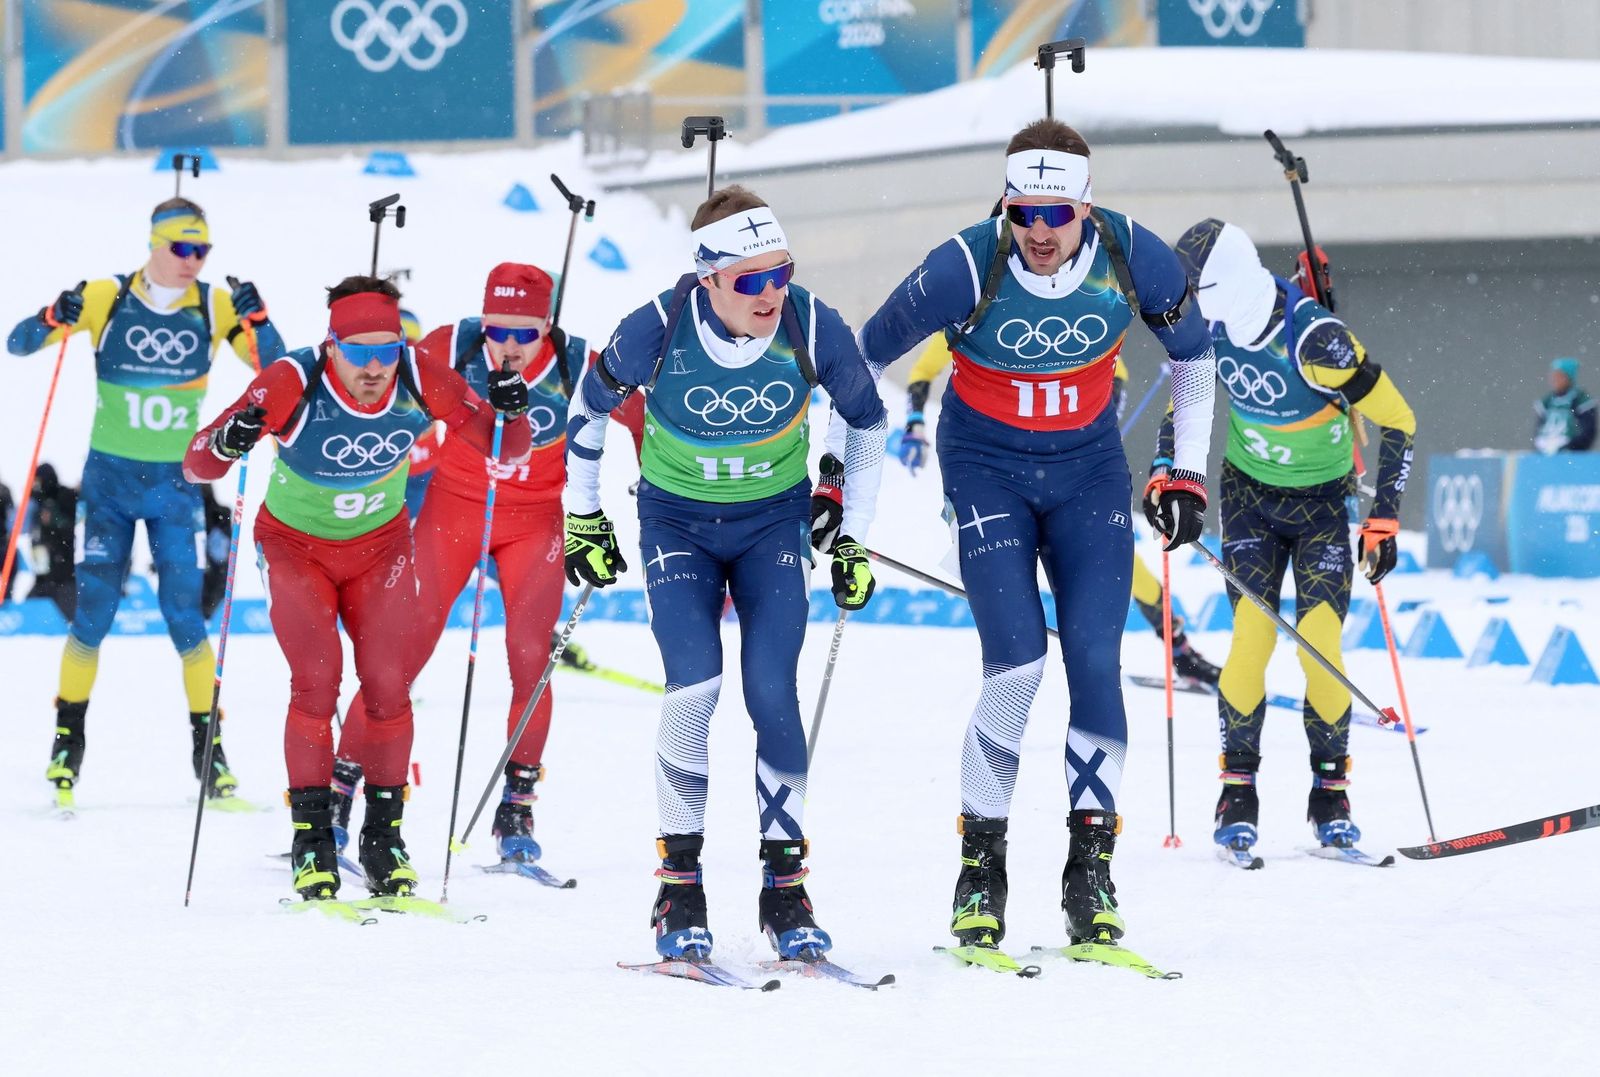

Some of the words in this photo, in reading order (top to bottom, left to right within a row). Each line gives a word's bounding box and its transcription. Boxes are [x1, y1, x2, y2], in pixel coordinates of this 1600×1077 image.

[743, 237, 782, 251] FINLAND
[494, 286, 514, 297] SUI
[1395, 449, 1414, 492] SWE
[968, 537, 1020, 559] FINLAND
[1318, 561, 1344, 573] SWE
[648, 572, 698, 590] FINLAND
[1447, 830, 1507, 850] ROSSIGNOL
